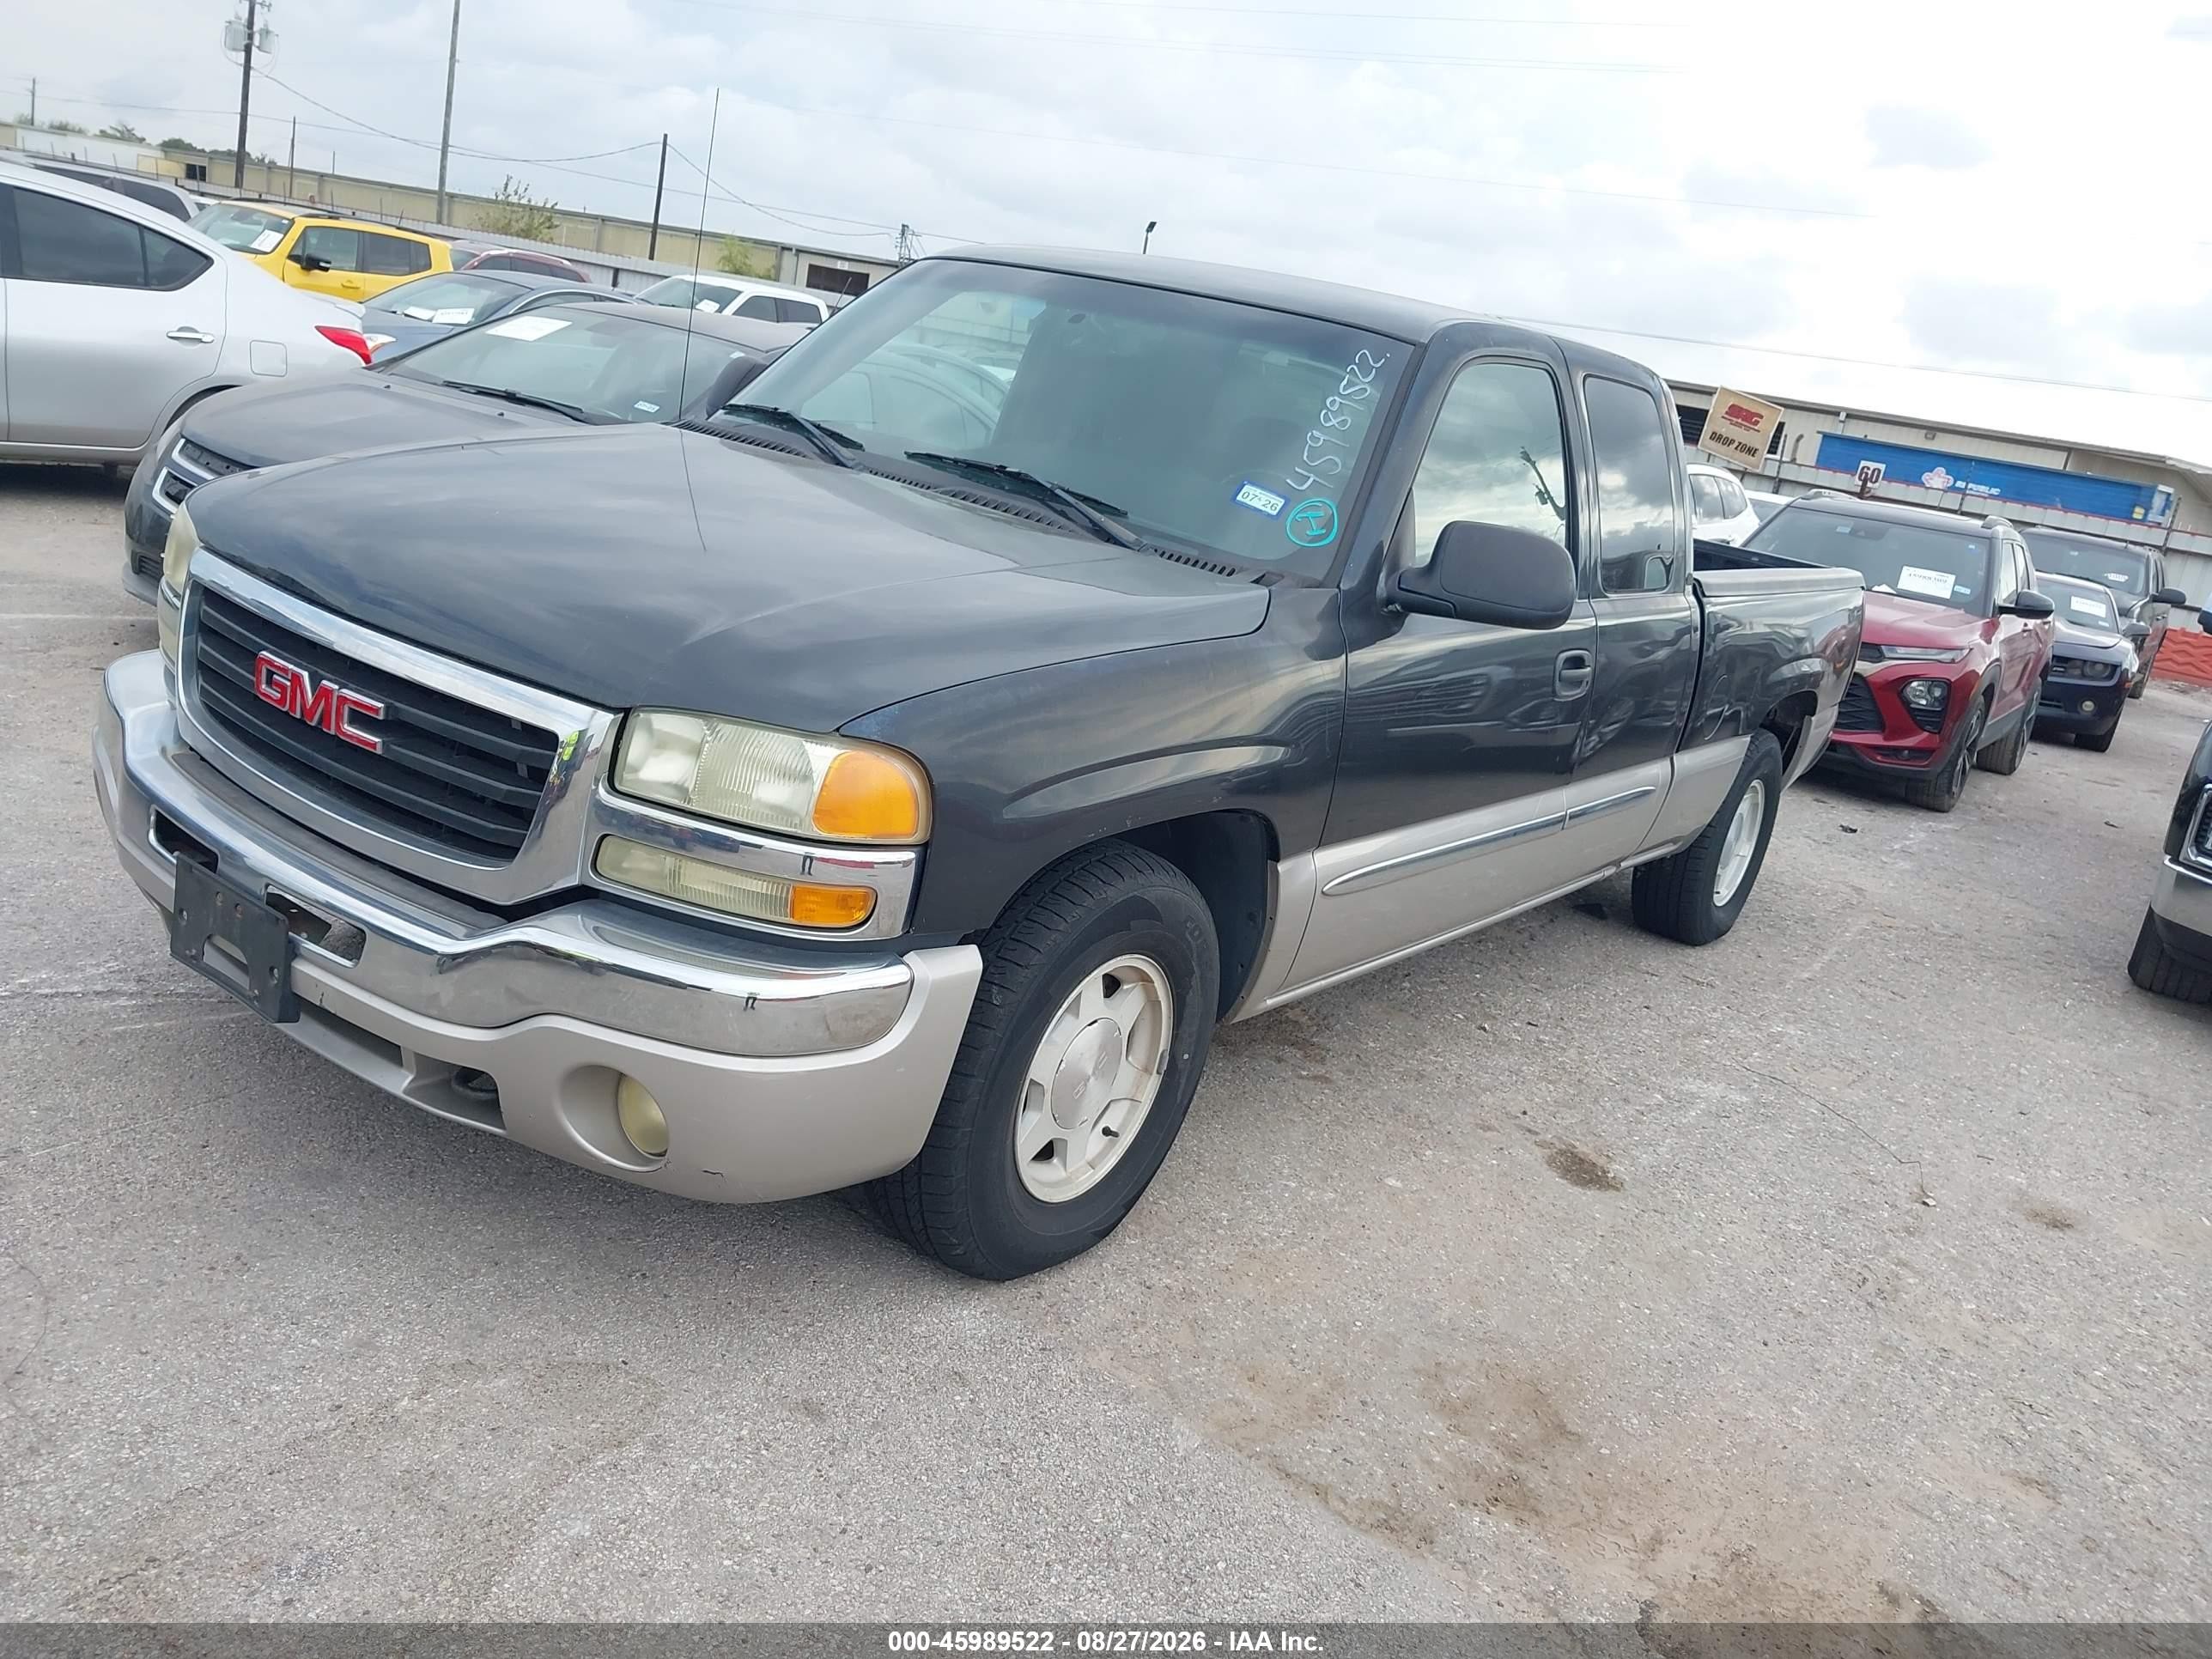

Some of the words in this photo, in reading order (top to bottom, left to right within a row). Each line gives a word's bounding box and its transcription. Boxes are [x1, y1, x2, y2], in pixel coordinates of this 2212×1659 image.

[1709, 431, 1736, 448] DROP
[1735, 441, 1759, 458] ZONE
[1857, 465, 1882, 484] 60
[254, 650, 385, 755] GMC
